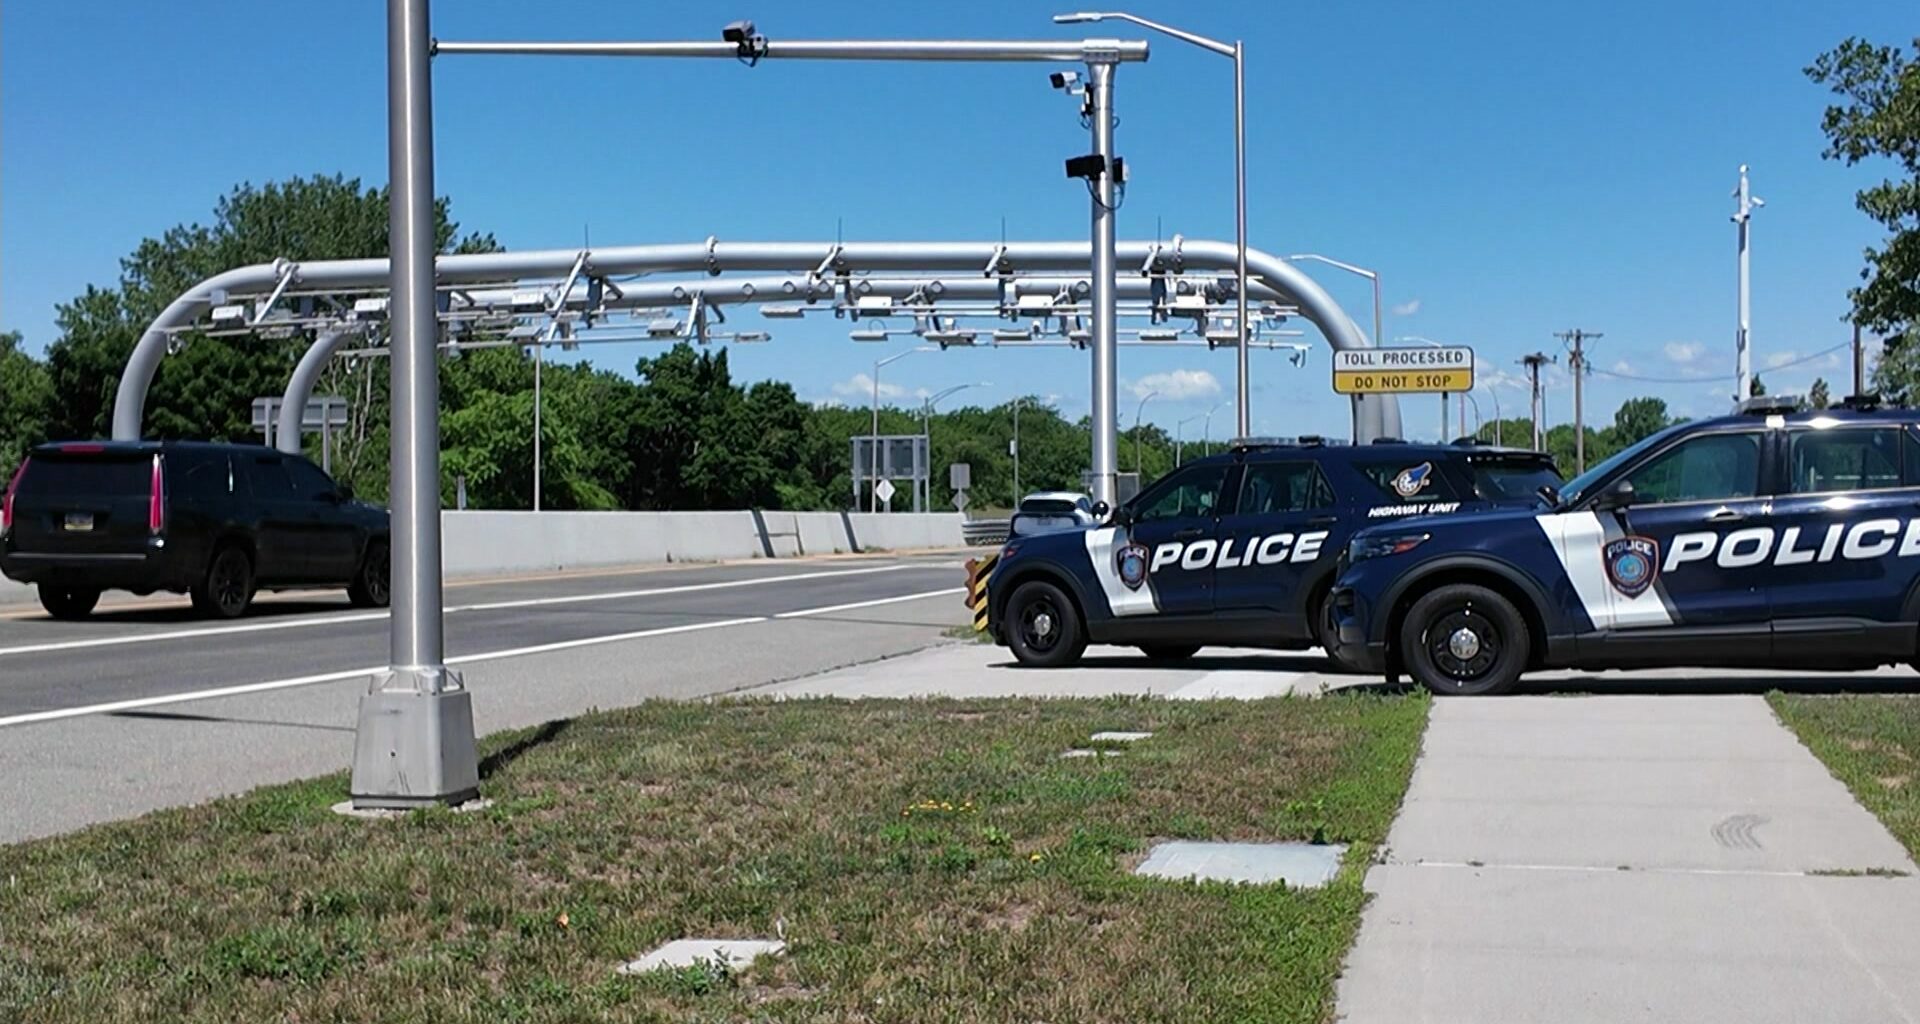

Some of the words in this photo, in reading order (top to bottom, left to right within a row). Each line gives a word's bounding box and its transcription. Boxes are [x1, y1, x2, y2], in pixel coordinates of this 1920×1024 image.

[1344, 353, 1375, 365] TOLL
[1382, 351, 1463, 364] PROCESSED
[1354, 377, 1373, 388] DO
[1381, 376, 1408, 388] NOT
[1416, 375, 1452, 387] STOP
[1368, 504, 1427, 517] HIGHWAY
[1428, 502, 1460, 513] UNIT
[1150, 531, 1329, 573] POLICE
[1607, 540, 1652, 559] POLICE
